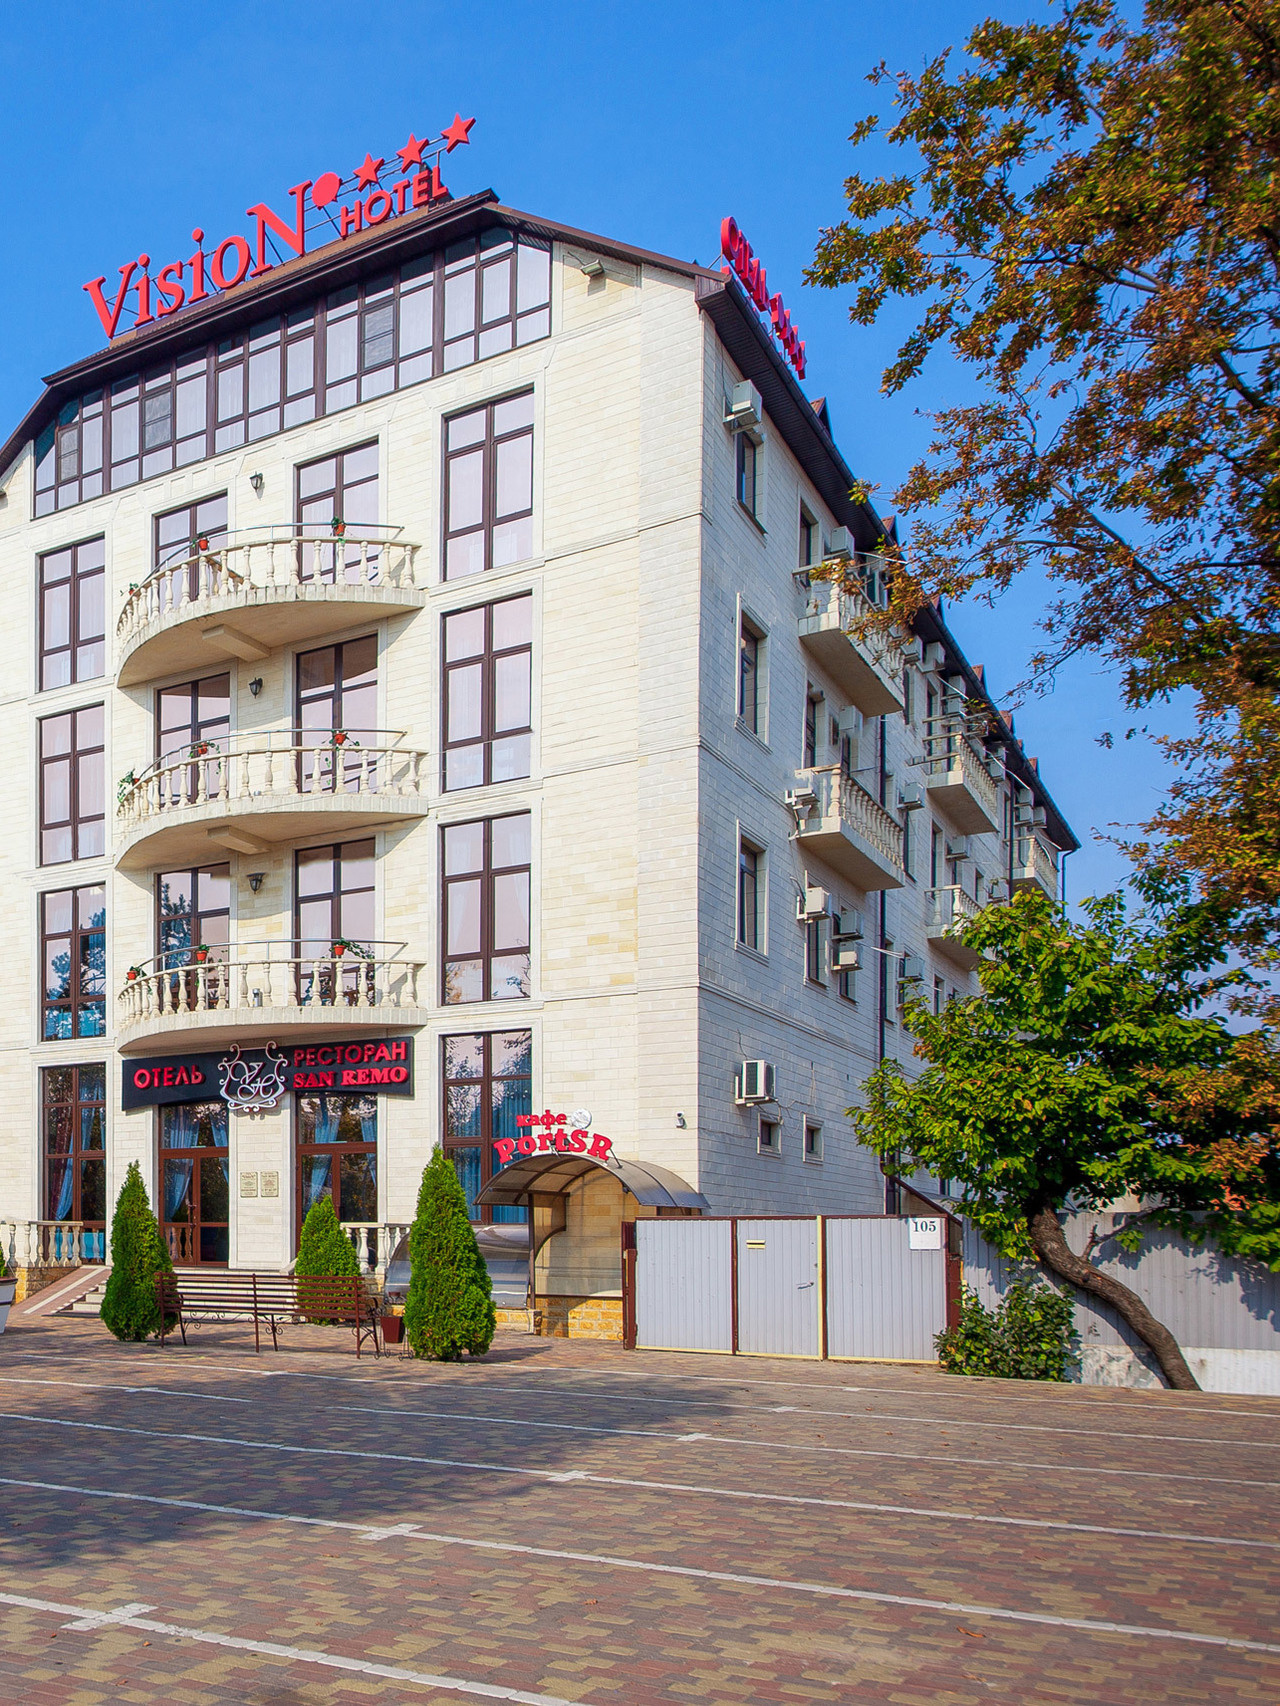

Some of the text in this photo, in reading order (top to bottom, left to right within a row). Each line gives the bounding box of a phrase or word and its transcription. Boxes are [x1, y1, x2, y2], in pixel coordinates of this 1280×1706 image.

[340, 166, 449, 239] HOTEL
[293, 1041, 407, 1068] РЕСТОРАН
[133, 1064, 206, 1089] ОТЕЛЬ
[293, 1066, 409, 1089] SAN REMO
[913, 1220, 937, 1233] 105
